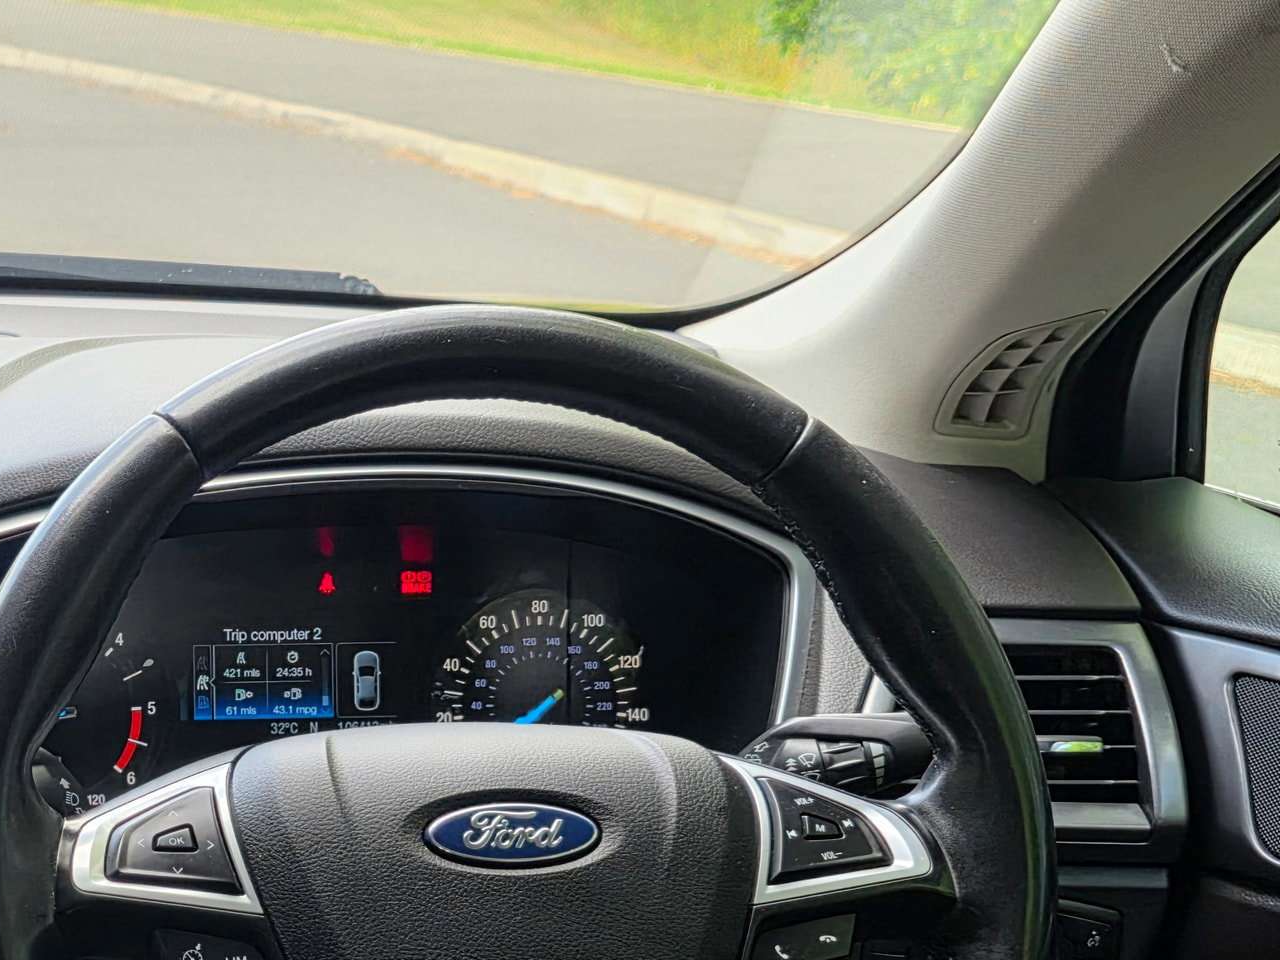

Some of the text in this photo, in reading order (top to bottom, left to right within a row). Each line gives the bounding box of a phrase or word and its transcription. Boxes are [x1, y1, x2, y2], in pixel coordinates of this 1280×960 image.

[531, 600, 548, 613] 80
[479, 615, 496, 629] 60
[582, 614, 605, 627] 100
[115, 632, 124, 646] 4
[223, 628, 321, 643] Trip computer 2
[443, 658, 460, 672] 40
[619, 655, 641, 668] 120
[223, 668, 261, 678] 421 mls
[276, 667, 312, 677] 24:35 h
[475, 678, 487, 688] 60
[593, 681, 610, 690] 200
[147, 701, 157, 715] 5
[225, 706, 257, 715] 61 mls
[272, 705, 317, 716] 43.1 mpg
[471, 701, 482, 710] 40
[596, 702, 612, 711] 220
[436, 711, 453, 723] 20
[626, 708, 649, 721] 140
[270, 722, 319, 735] 32°C N
[126, 771, 136, 785] 6
[87, 794, 106, 806] 120
[463, 810, 564, 849] Ford
[815, 823, 826, 832] M
[168, 836, 185, 845] OK
